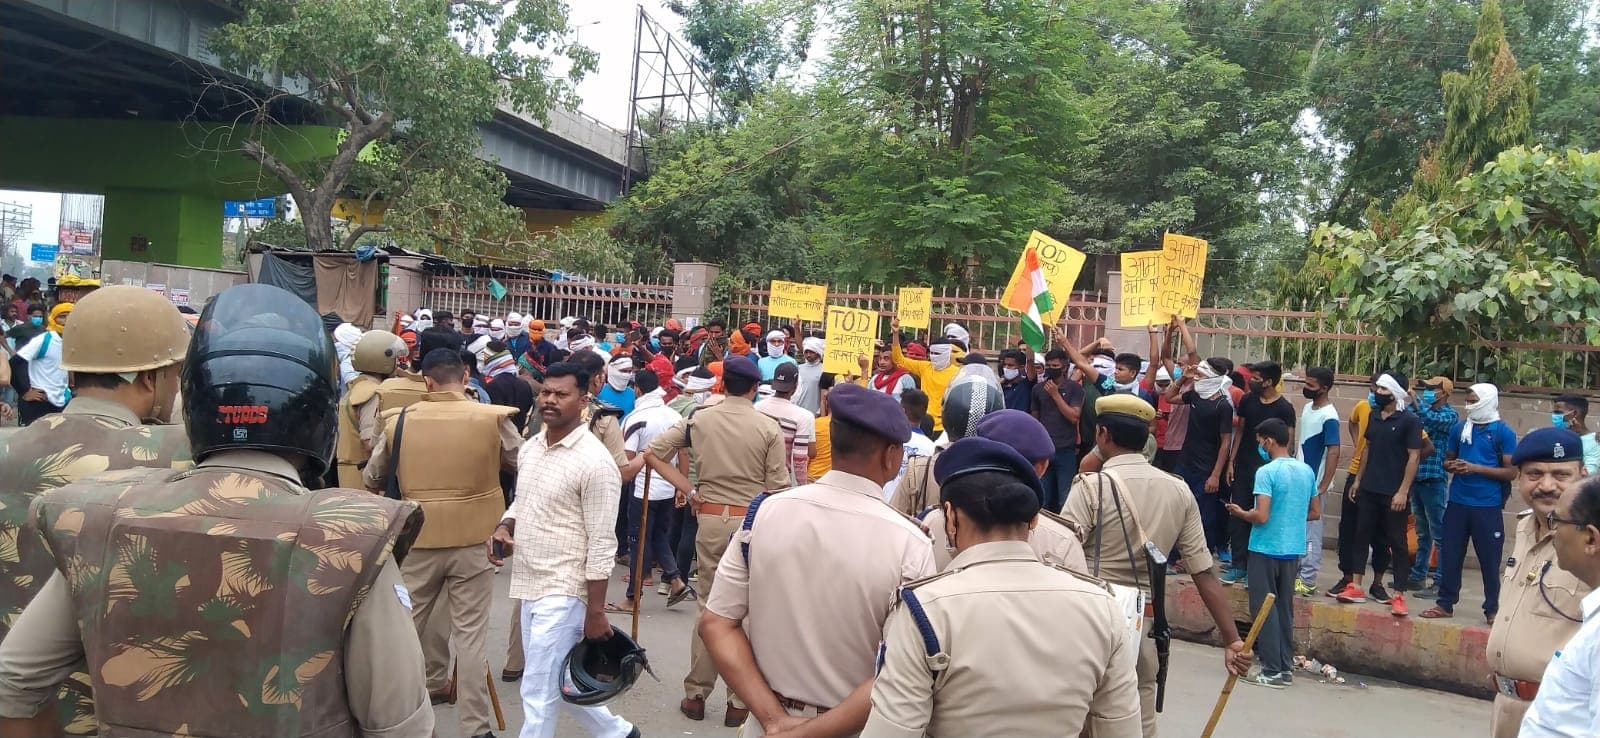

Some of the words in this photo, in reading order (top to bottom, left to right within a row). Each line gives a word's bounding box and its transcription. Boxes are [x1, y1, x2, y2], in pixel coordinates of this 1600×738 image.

[1034, 237, 1067, 264] TOD
[1124, 297, 1146, 317] CEE
[1161, 290, 1181, 309] CEE
[830, 309, 871, 332] TOD
